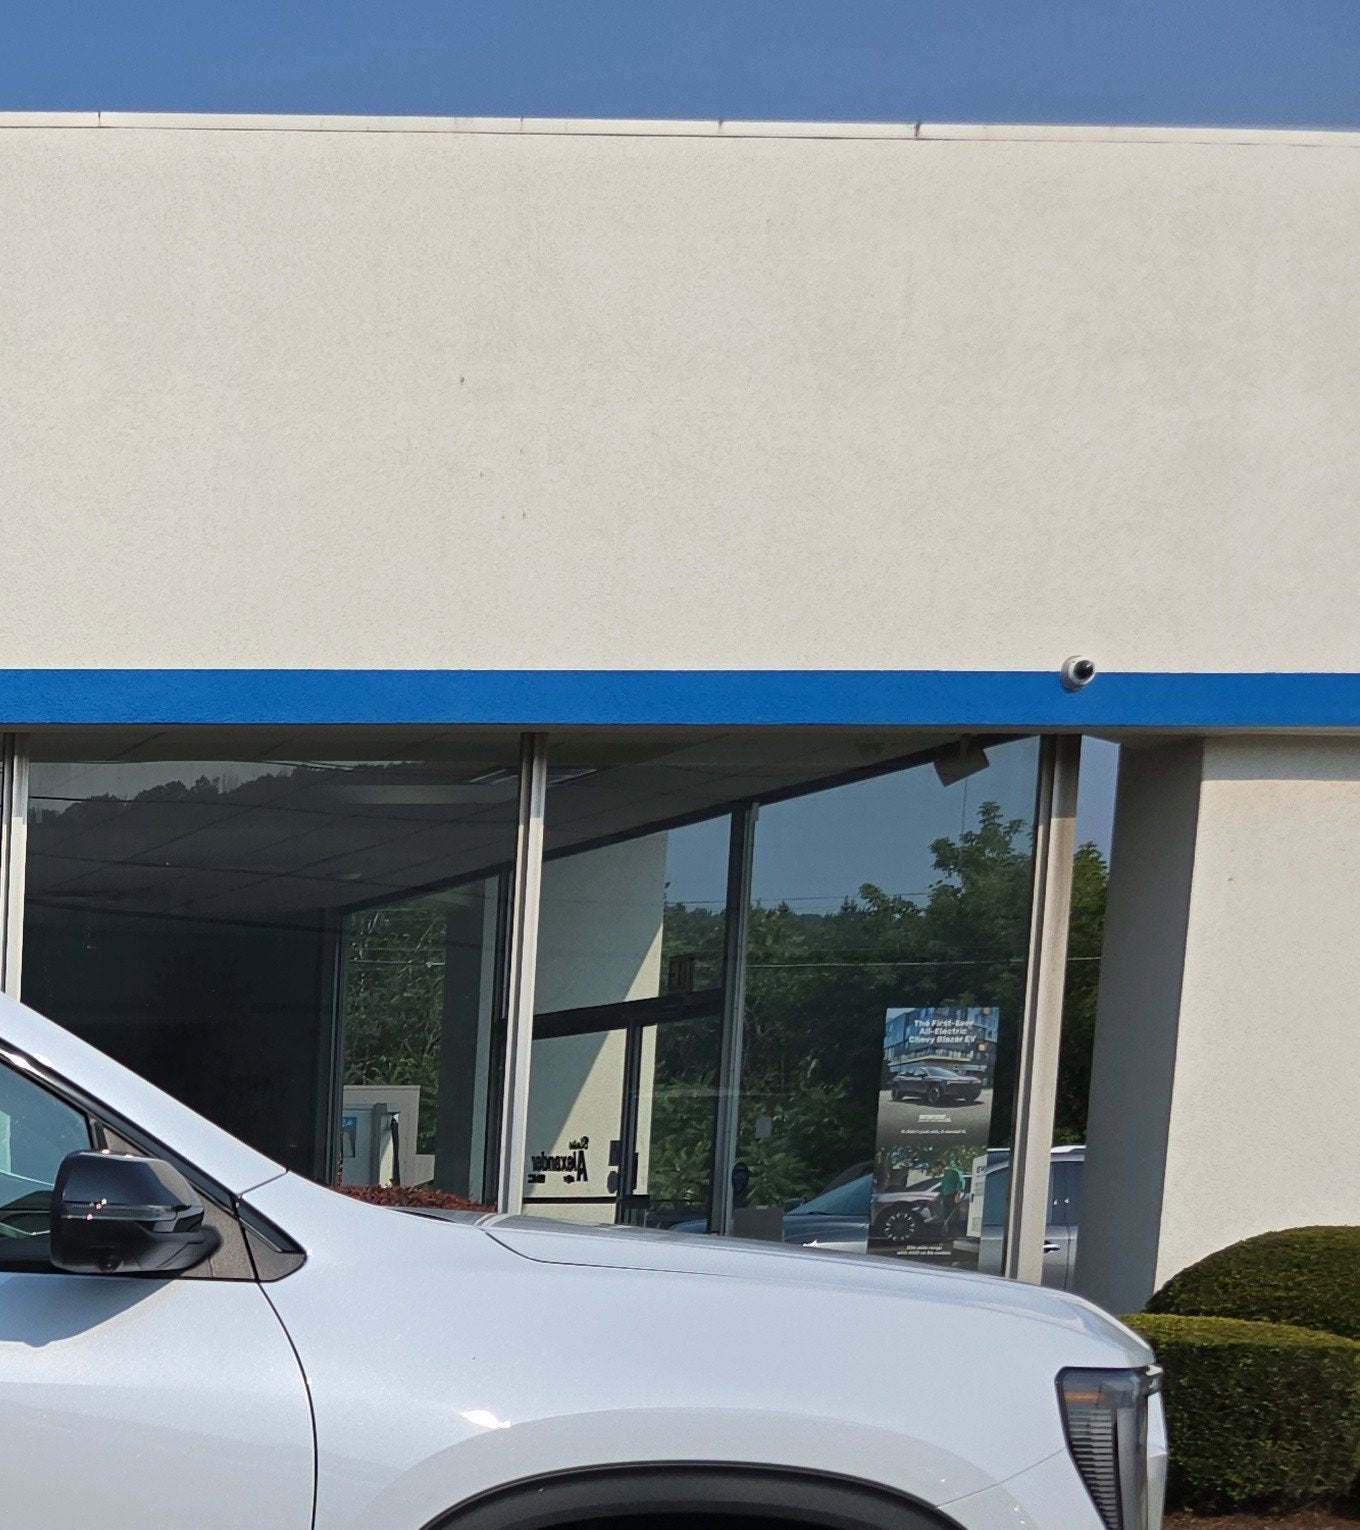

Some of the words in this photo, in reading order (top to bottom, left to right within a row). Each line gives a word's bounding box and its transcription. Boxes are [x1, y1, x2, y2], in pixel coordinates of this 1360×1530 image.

[914, 1019, 930, 1027] The
[919, 1027, 968, 1035] All-Electric
[908, 1035, 935, 1044] Chevy
[936, 1035, 964, 1043] Blazer
[964, 1035, 976, 1043] EV
